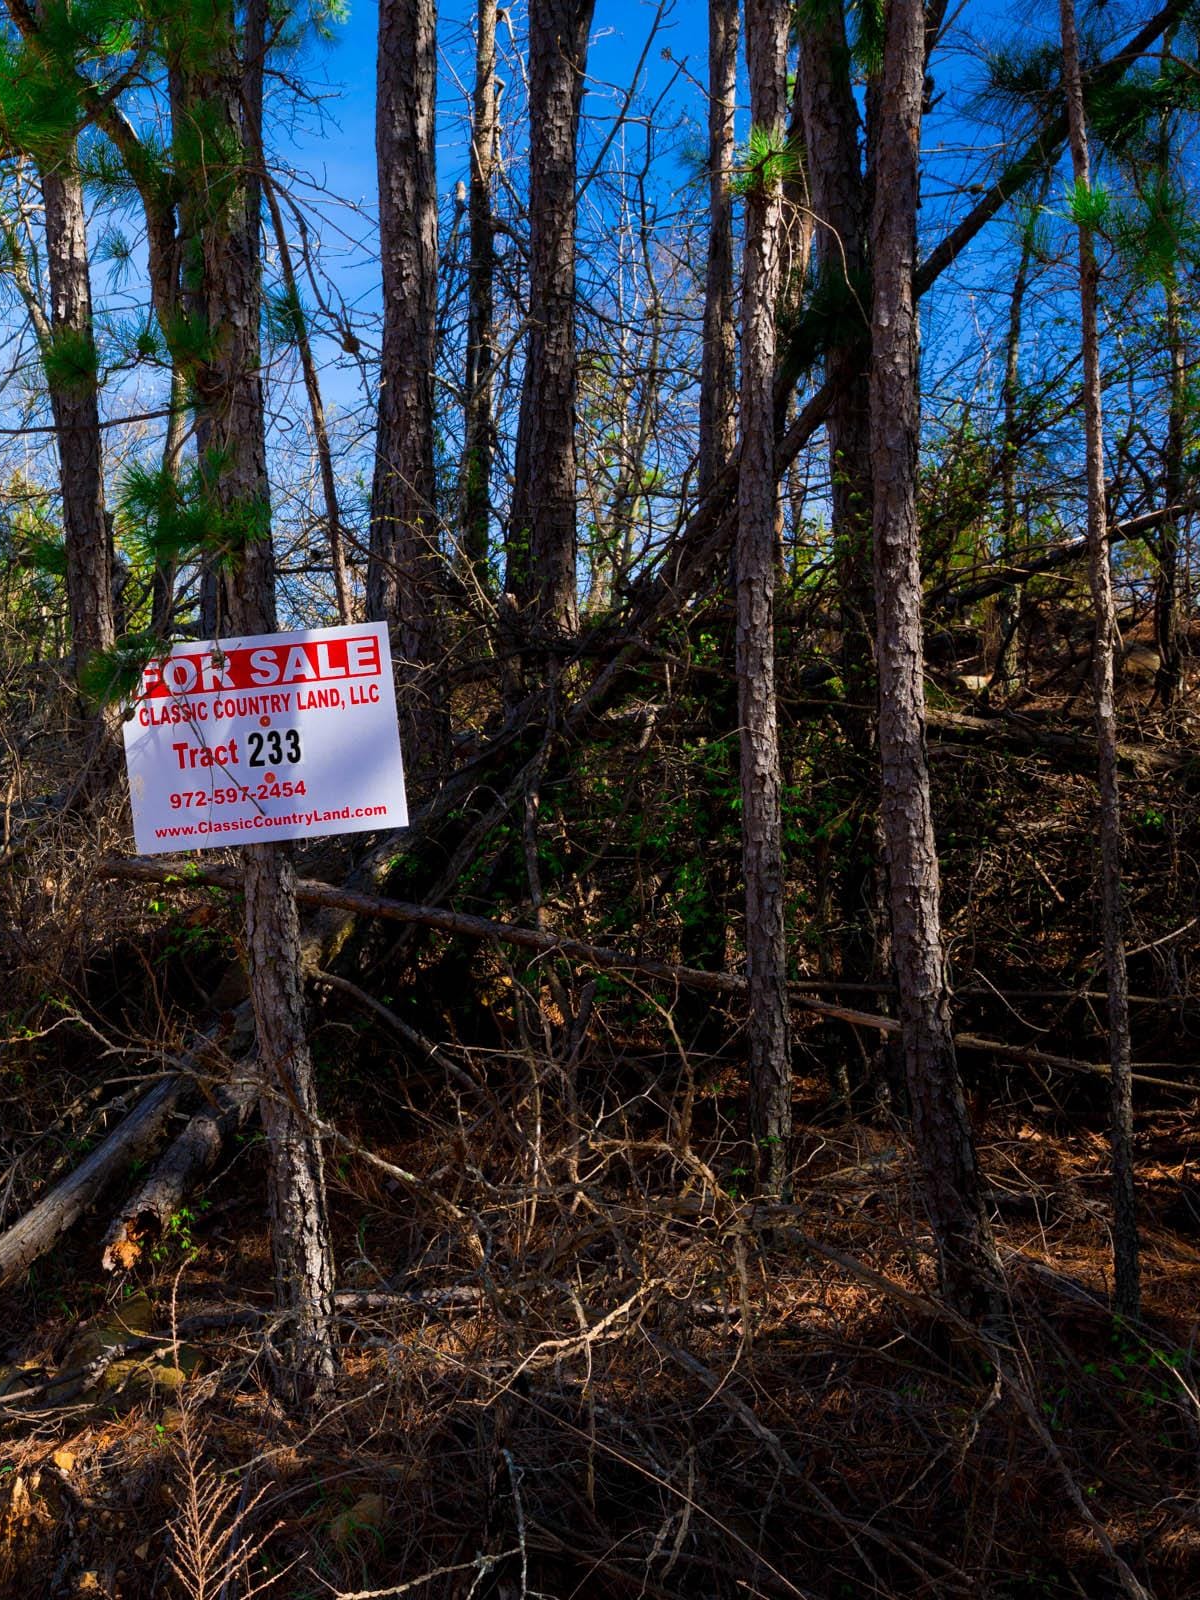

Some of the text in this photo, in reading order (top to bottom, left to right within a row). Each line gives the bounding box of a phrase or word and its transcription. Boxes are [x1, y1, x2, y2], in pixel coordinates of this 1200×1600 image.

[138, 638, 378, 697] FOR SALE
[139, 683, 380, 727] CLASSIC COUNTRY LAND, LLC
[172, 729, 302, 769] Tract 233
[169, 780, 307, 810] 972-597-2454
[154, 804, 388, 839] www.ClassicCountryLand.com
